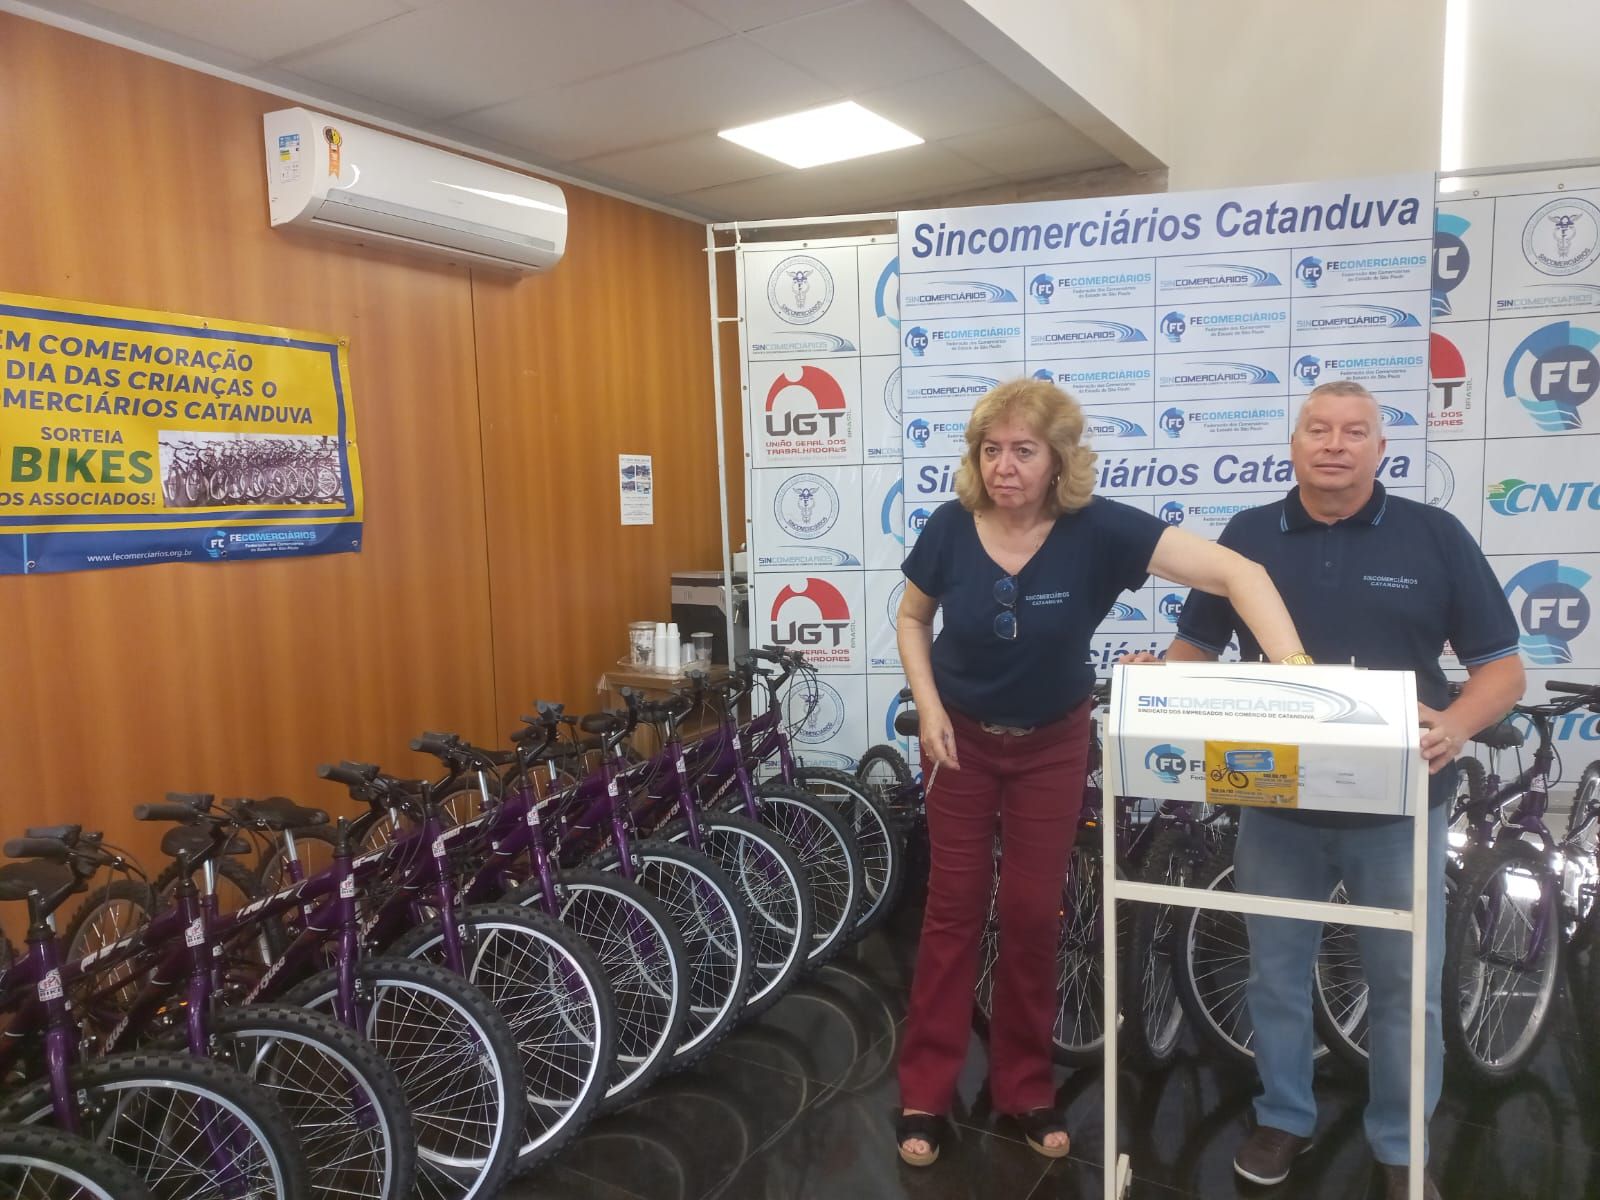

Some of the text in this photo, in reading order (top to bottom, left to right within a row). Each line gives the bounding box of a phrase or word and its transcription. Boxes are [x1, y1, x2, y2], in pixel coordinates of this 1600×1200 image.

[912, 194, 1420, 258] Sincomerciários Catanduva
[0, 330, 253, 373] M COMEMORAÇÃO
[6, 359, 277, 399] DIA DAS CRIANÇAS O
[1540, 360, 1591, 395] FC
[0, 388, 312, 424] MERCIÁRIOS CATANDUVA
[40, 426, 124, 444] SORTEIA
[766, 411, 846, 438] UGT
[766, 439, 792, 447] UNIÃO
[767, 446, 847, 455] TRABALHADORES
[11, 446, 153, 484] BIKES
[29, 492, 156, 506] ASSOCIADOS!
[87, 549, 193, 563] www.fecomerciarios.org.br
[1531, 598, 1581, 629] FC
[771, 621, 850, 648] UGT
[1159, 757, 1182, 772] FC
